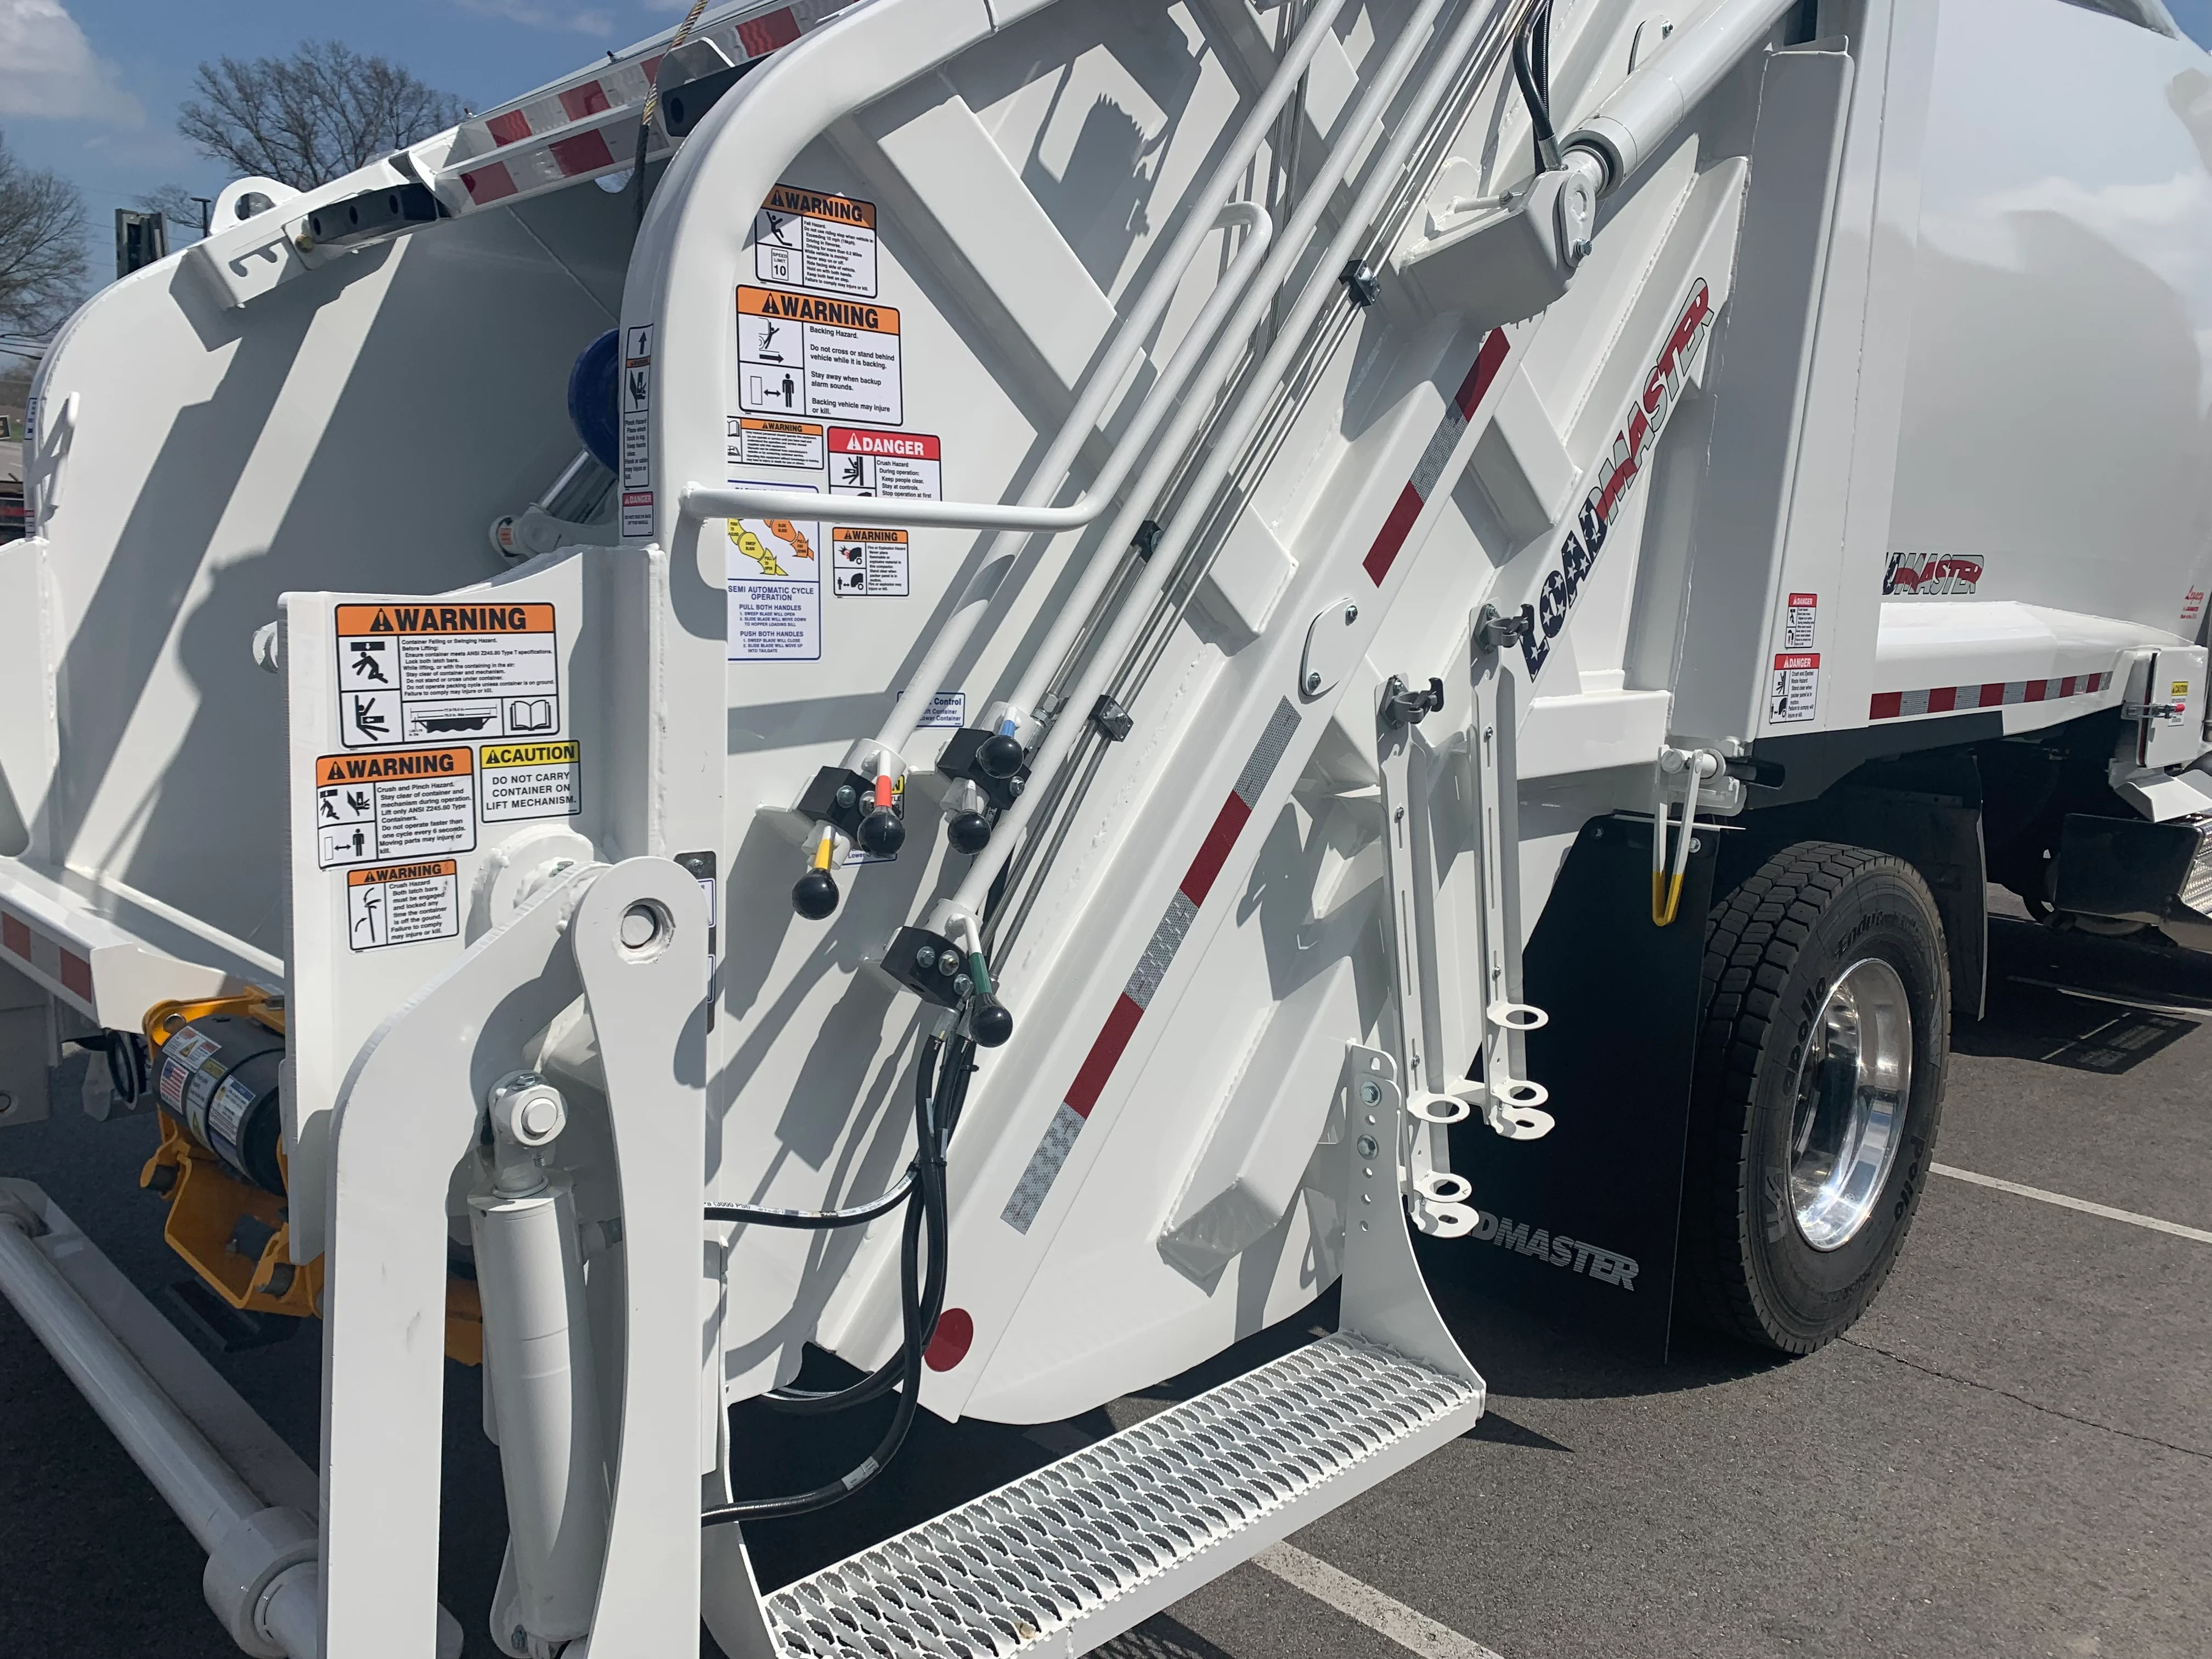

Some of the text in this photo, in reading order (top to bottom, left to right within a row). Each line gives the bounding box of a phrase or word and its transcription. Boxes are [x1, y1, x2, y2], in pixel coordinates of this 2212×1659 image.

[785, 191, 863, 222] WARNING
[774, 264, 786, 276] 10
[780, 295, 878, 329] WARNING
[810, 326, 858, 338] Backing Hazard.
[875, 353, 894, 361] behind
[862, 360, 887, 370] backing.
[811, 371, 825, 380] Stay
[826, 374, 842, 382] away
[860, 377, 881, 386] backup
[812, 398, 836, 408] Backing
[874, 404, 890, 413] injure
[768, 422, 803, 432] WARNING
[862, 437, 924, 456] DANGER
[882, 476, 894, 484] Keep
[882, 483, 893, 491] Stay
[1521, 277, 1715, 683] LOADMASTER
[630, 495, 652, 503] DANGER
[851, 531, 898, 541] WARNING
[1882, 552, 1984, 595] DMASTER
[394, 607, 526, 631] WARNING
[1790, 658, 1811, 668] DANGER
[500, 745, 574, 764] CAUTION
[346, 754, 454, 778] WARNING
[493, 771, 571, 785] DO NOT CARRY
[493, 783, 571, 797] CONTAINER ON
[487, 795, 578, 810] LIFT MECHANISM.
[376, 864, 442, 882] WARNING
[419, 891, 444, 900] engaged
[420, 921, 442, 929] comply
[1472, 1210, 1639, 1291] DMASTER
